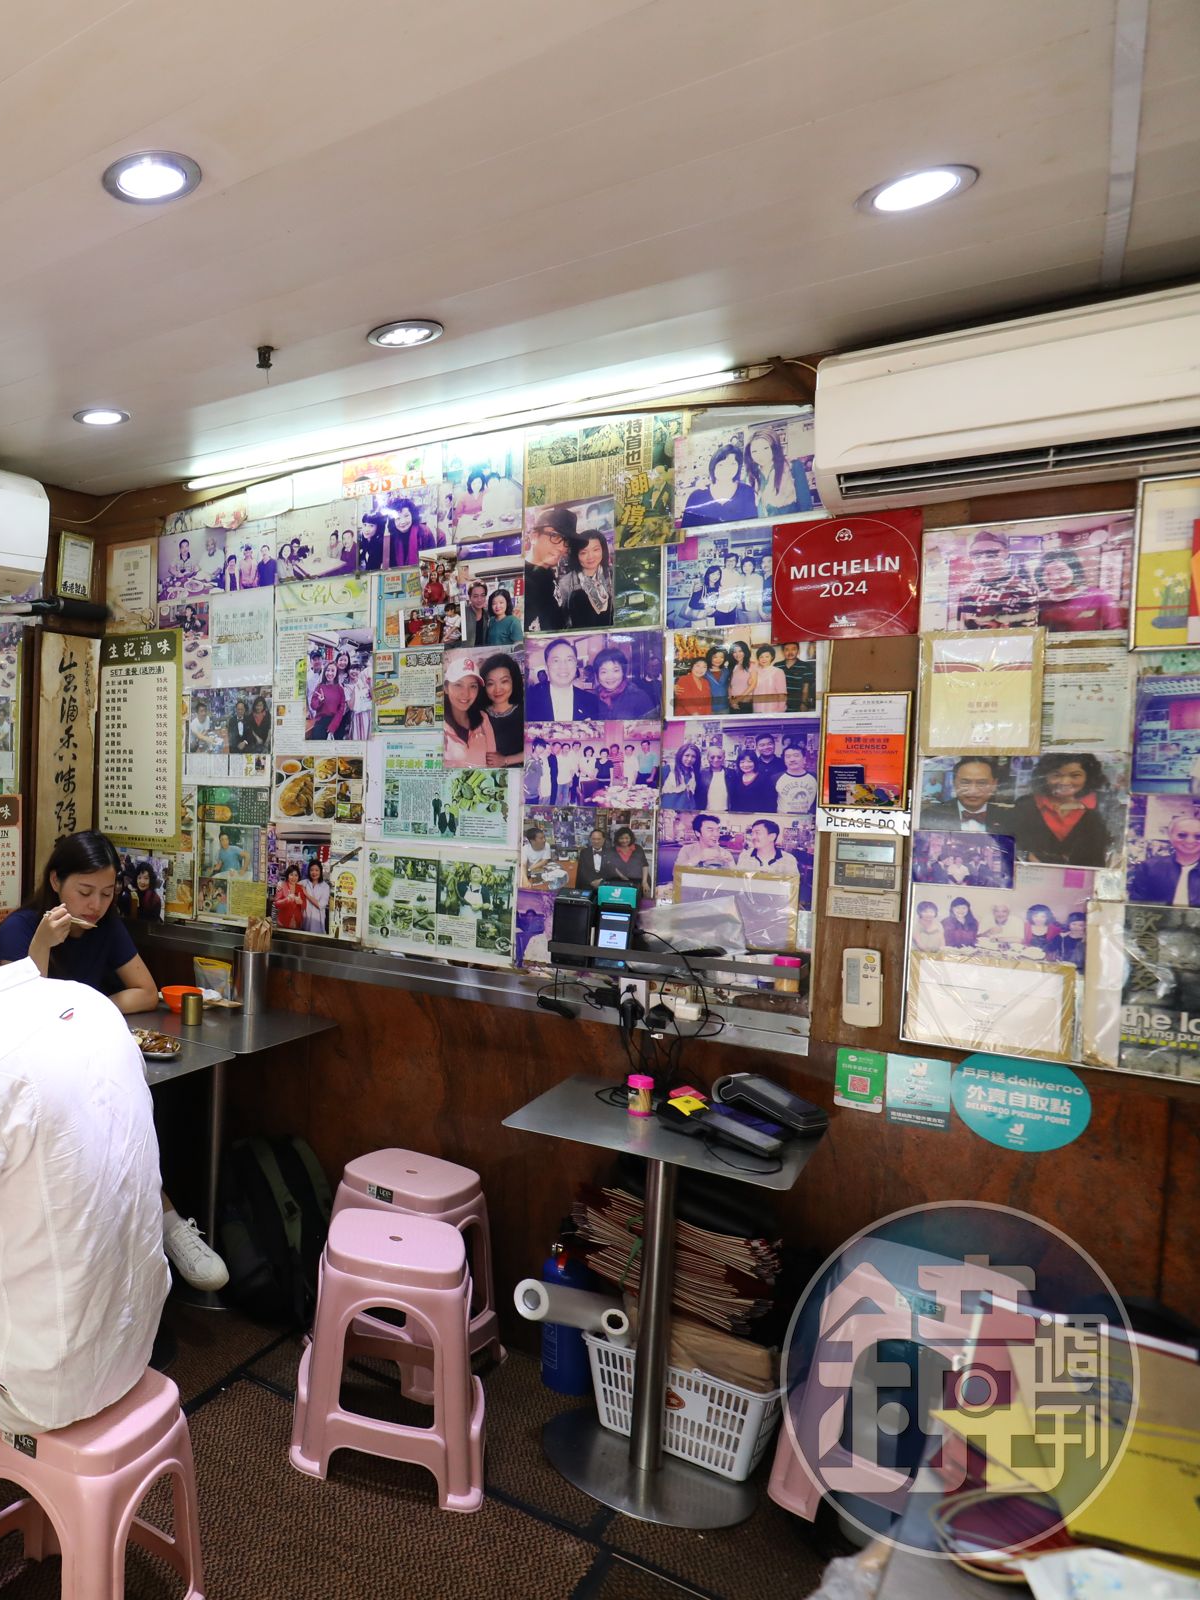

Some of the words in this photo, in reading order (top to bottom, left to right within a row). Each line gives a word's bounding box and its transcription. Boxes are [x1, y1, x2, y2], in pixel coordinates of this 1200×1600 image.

[790, 556, 900, 580] MICHELIN
[820, 580, 868, 598] 2024
[109, 639, 171, 658] 生記滷味
[826, 817, 871, 828] PLEASE
[878, 819, 895, 829] DO
[1121, 1004, 1172, 1030] the
[1121, 1026, 1141, 1036] sai
[1141, 1028, 1175, 1042] ying
[1008, 1075, 1083, 1095] deliveroo
[967, 1084, 1071, 1116] 外賣自取點
[966, 1101, 1010, 1114] DELIVEROO
[1011, 1109, 1042, 1120] PICKUP
[1045, 1115, 1070, 1126] POINT
